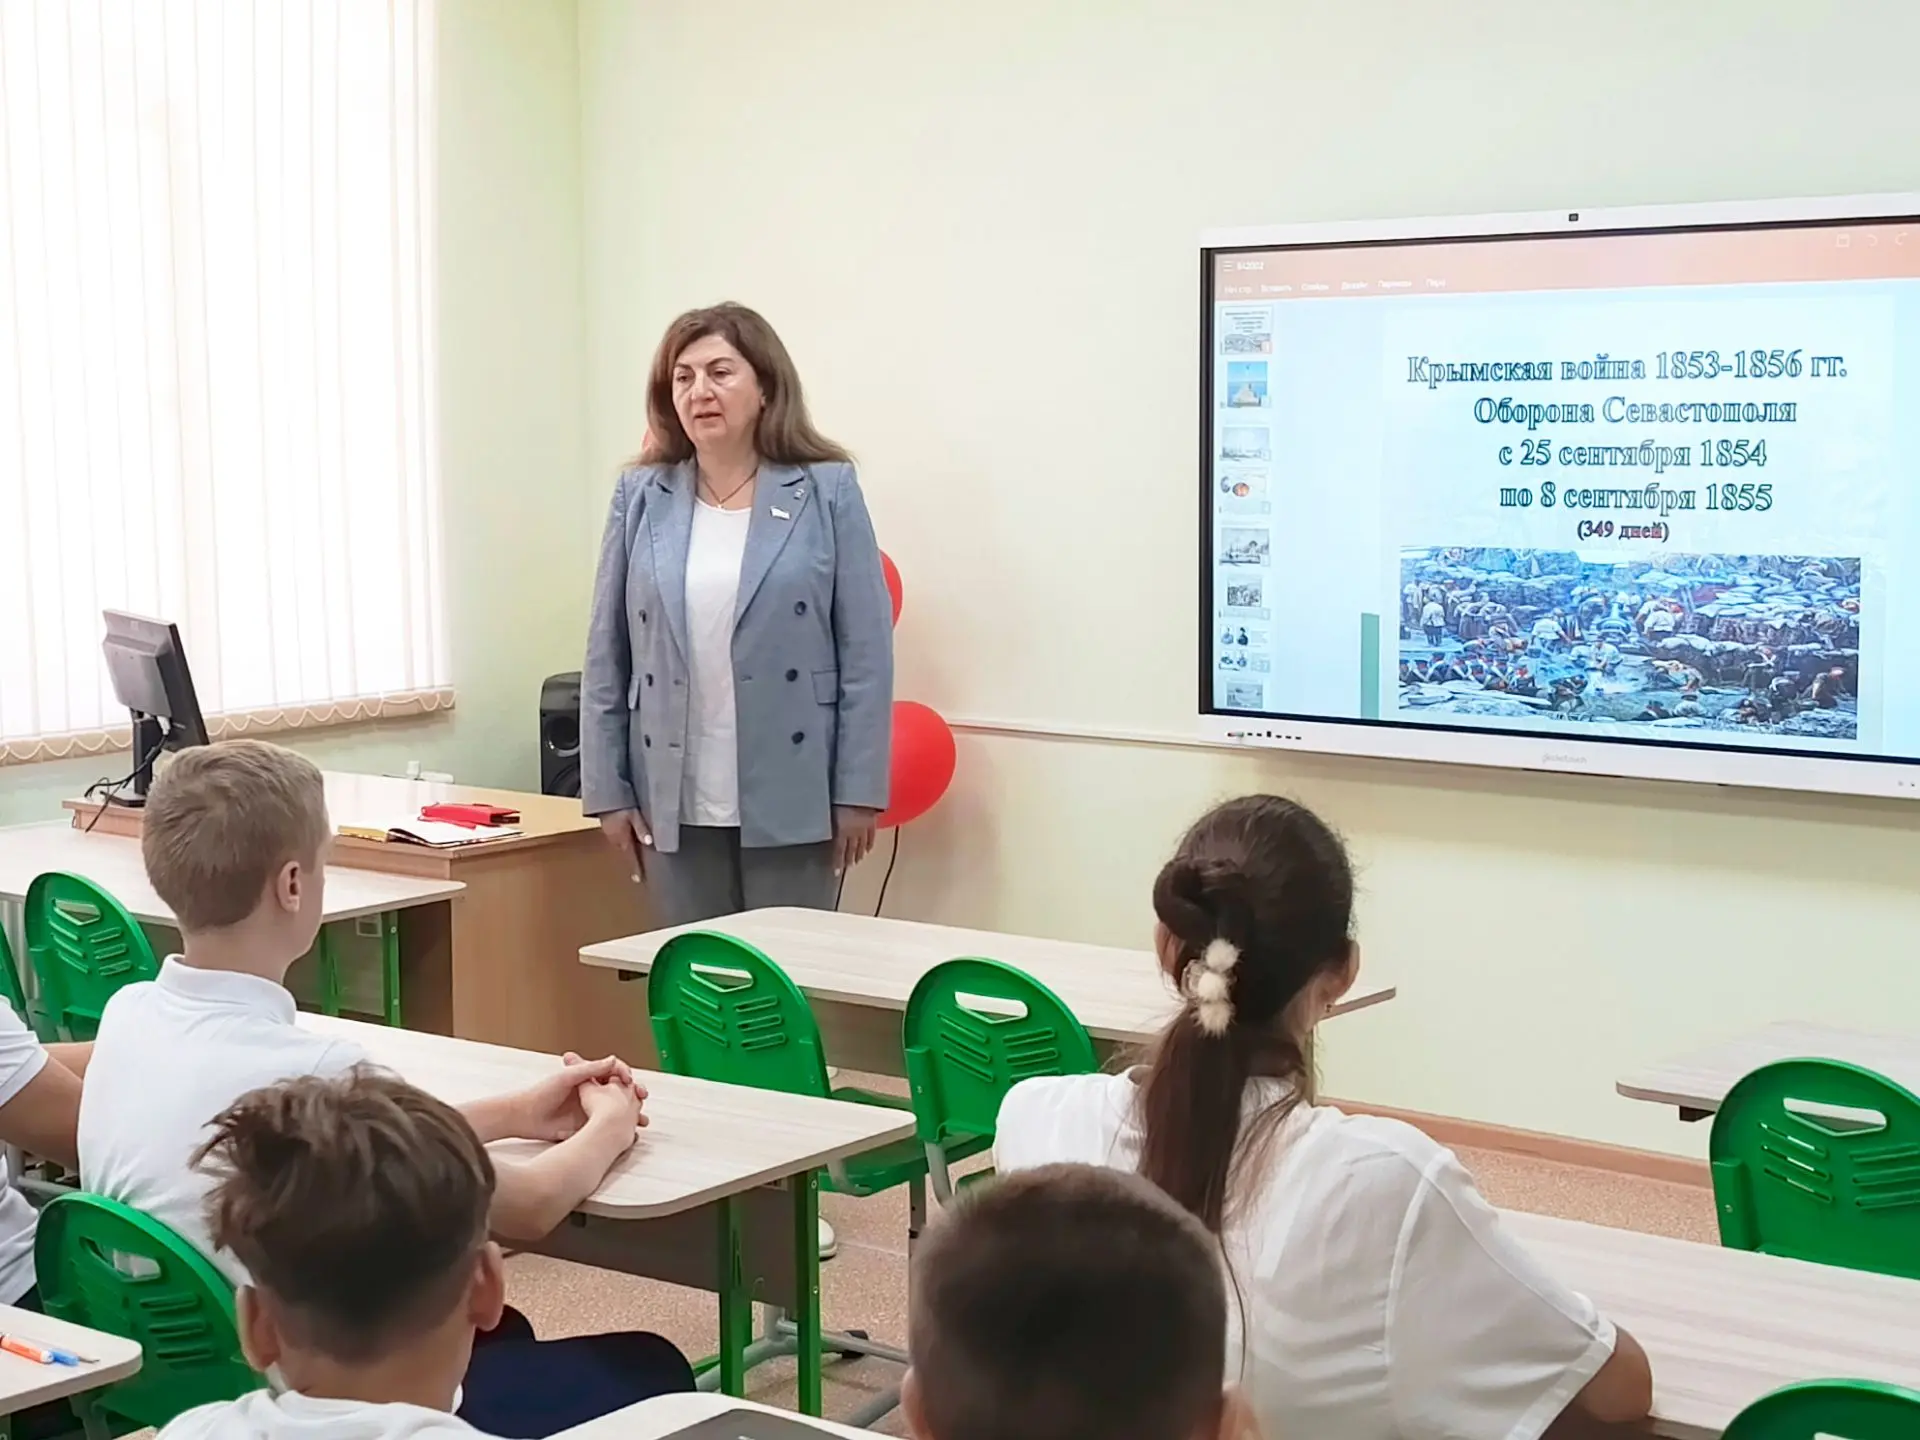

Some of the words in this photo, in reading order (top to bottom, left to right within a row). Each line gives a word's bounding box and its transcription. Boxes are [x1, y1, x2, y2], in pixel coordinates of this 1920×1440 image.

[1407, 356, 1553, 389] Крымская
[1561, 353, 1646, 381] война
[1656, 349, 1803, 379] 1853-1856
[1474, 396, 1595, 431] Оборона
[1602, 395, 1797, 423] Севастополя
[1499, 446, 1513, 466] с
[1520, 439, 1552, 466] 25
[1559, 439, 1691, 474] сентября
[1700, 439, 1768, 467] 1854
[1500, 487, 1533, 507] по
[1540, 481, 1556, 508] 8
[1563, 483, 1696, 517] сентября
[1705, 483, 1773, 511] 1855
[1576, 520, 1615, 541] (349
[1618, 521, 1670, 543] дней)
